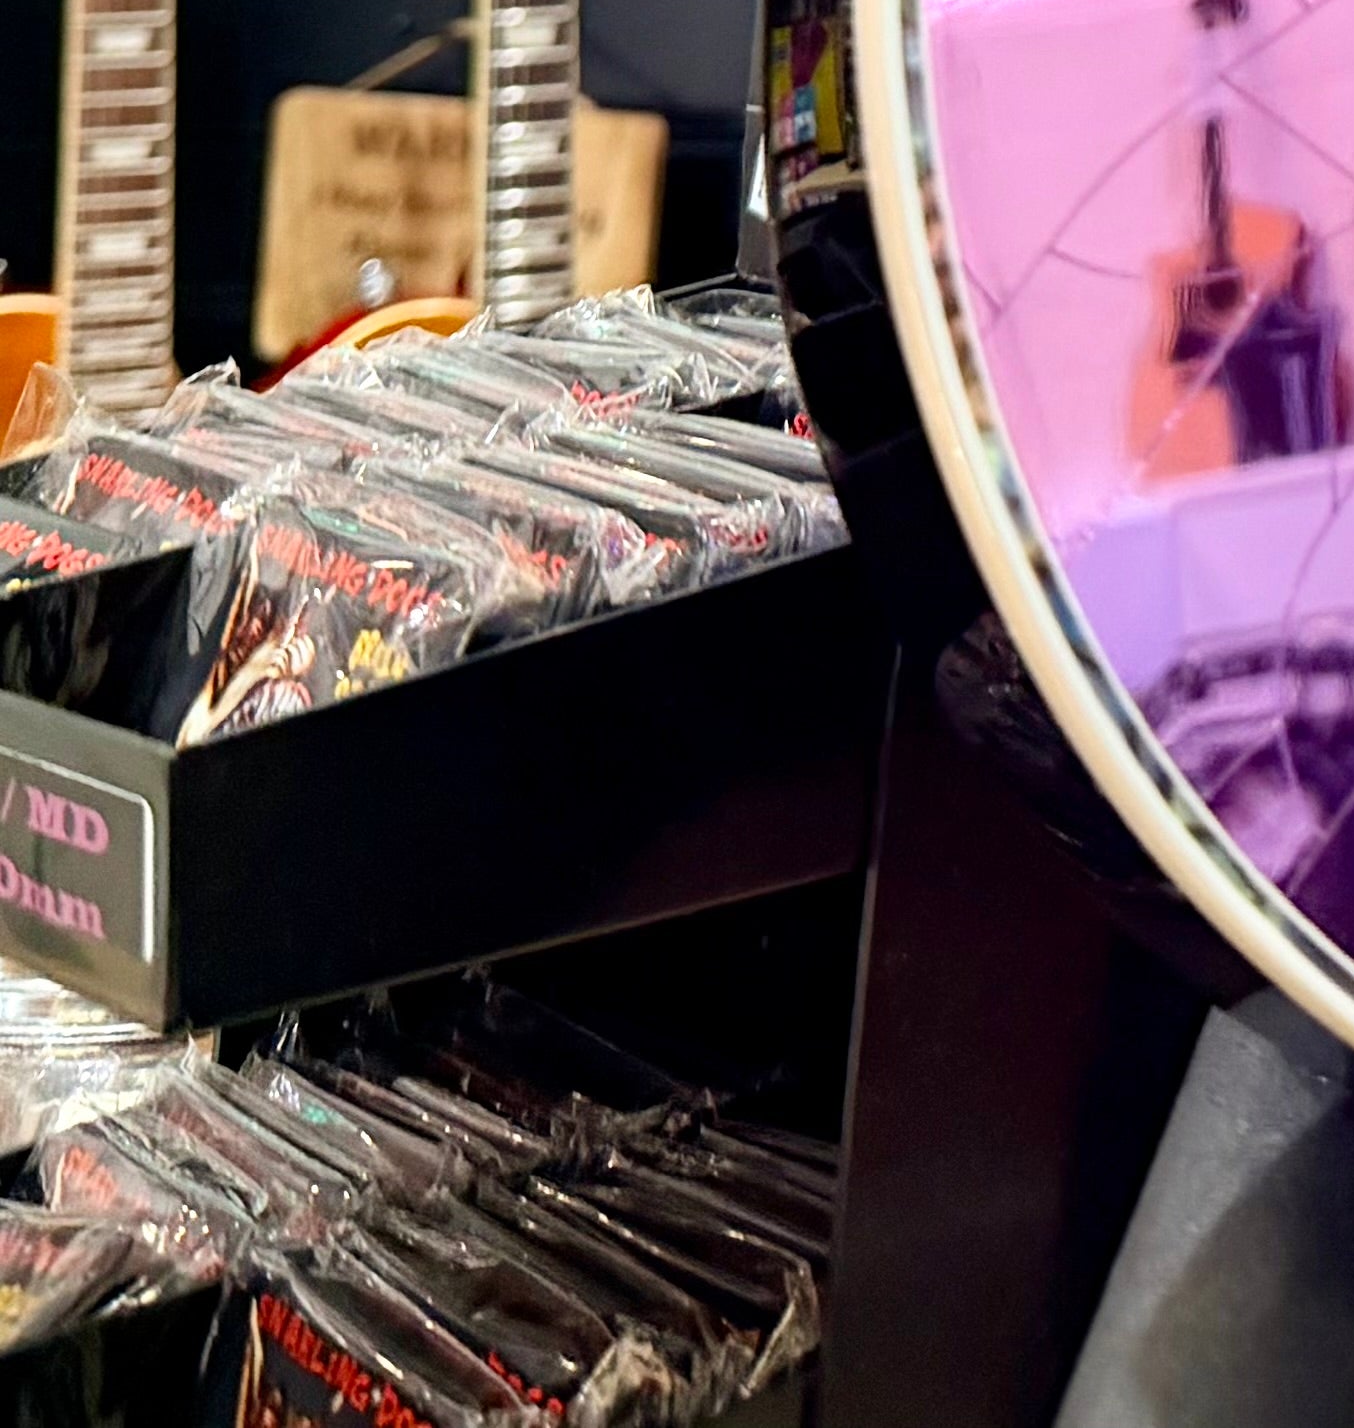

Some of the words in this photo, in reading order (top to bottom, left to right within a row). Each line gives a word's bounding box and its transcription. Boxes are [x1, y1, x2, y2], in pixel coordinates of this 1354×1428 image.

[258, 524, 369, 600] SNARLING
[25, 784, 110, 855] MD
[259, 1294, 372, 1412] SNARLING
